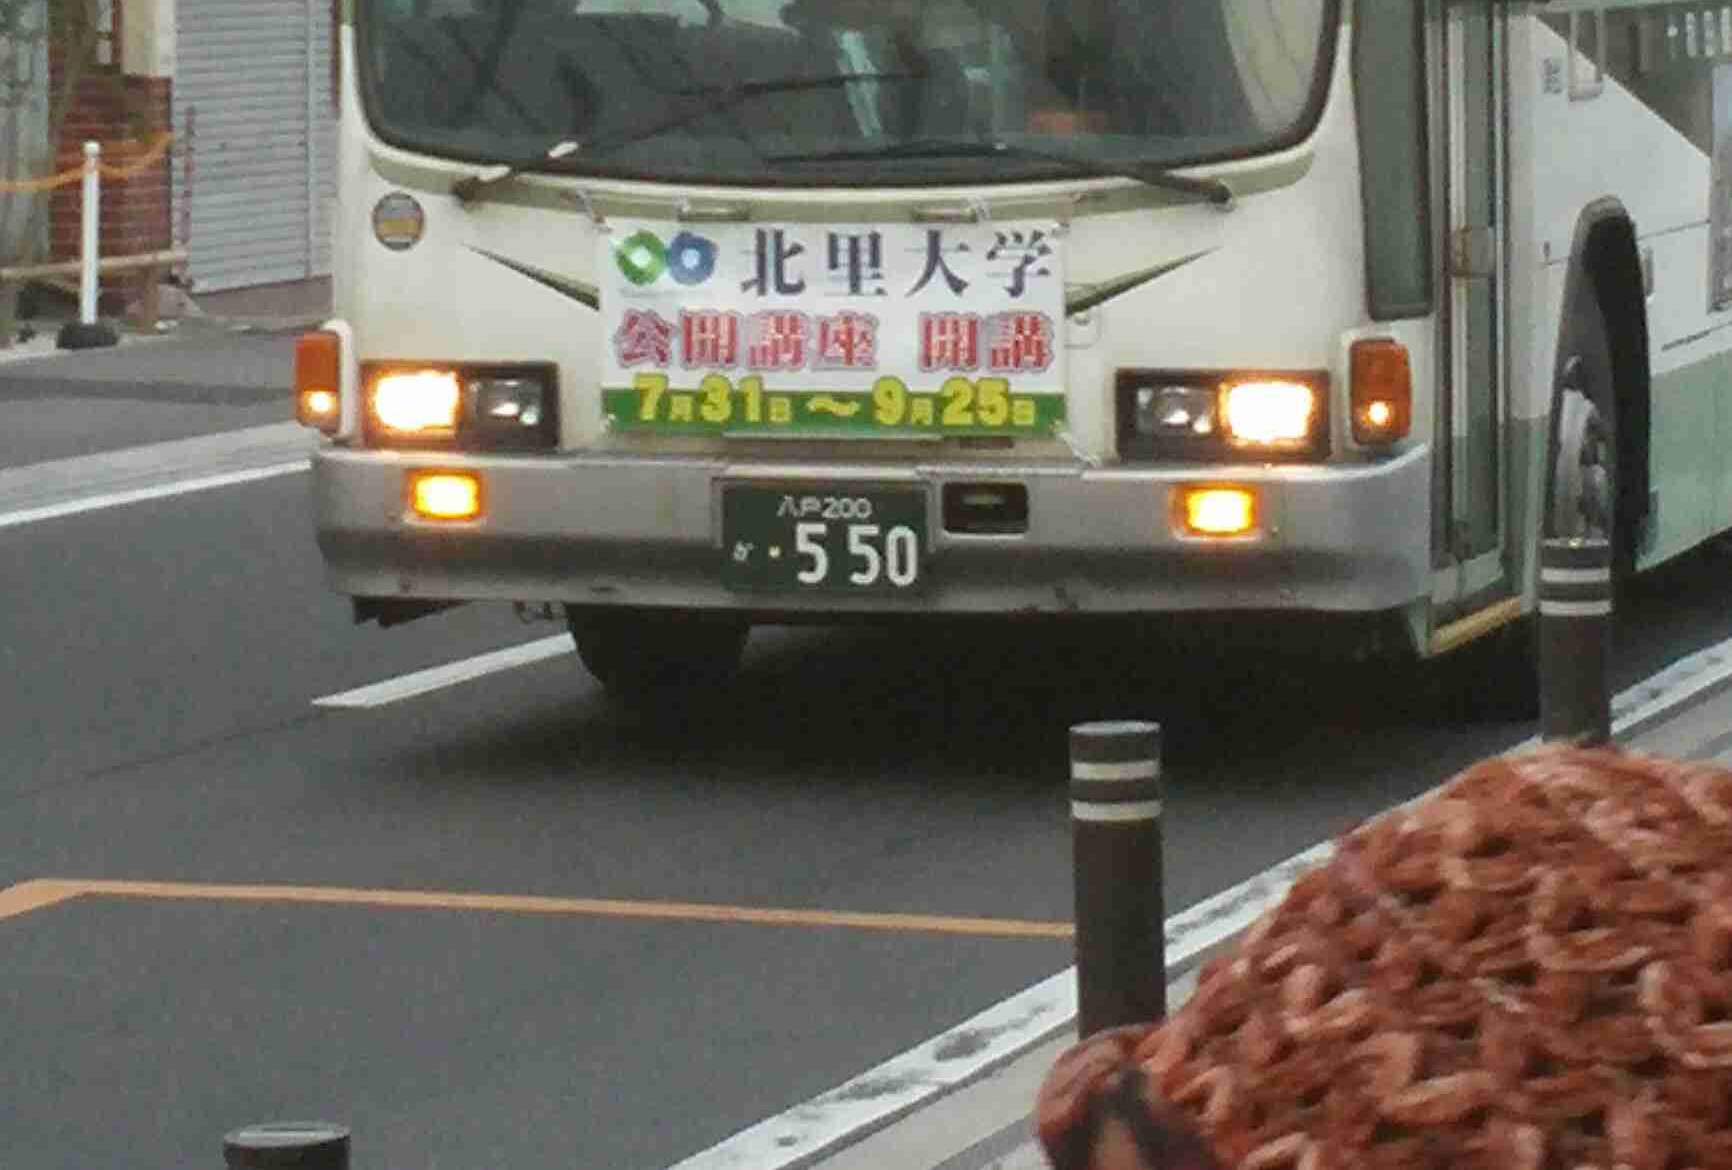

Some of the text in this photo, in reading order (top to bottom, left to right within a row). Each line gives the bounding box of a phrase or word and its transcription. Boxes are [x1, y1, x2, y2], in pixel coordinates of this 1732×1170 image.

[740, 229, 1054, 297] 北里大学
[615, 309, 1056, 372] 公開講座 開講
